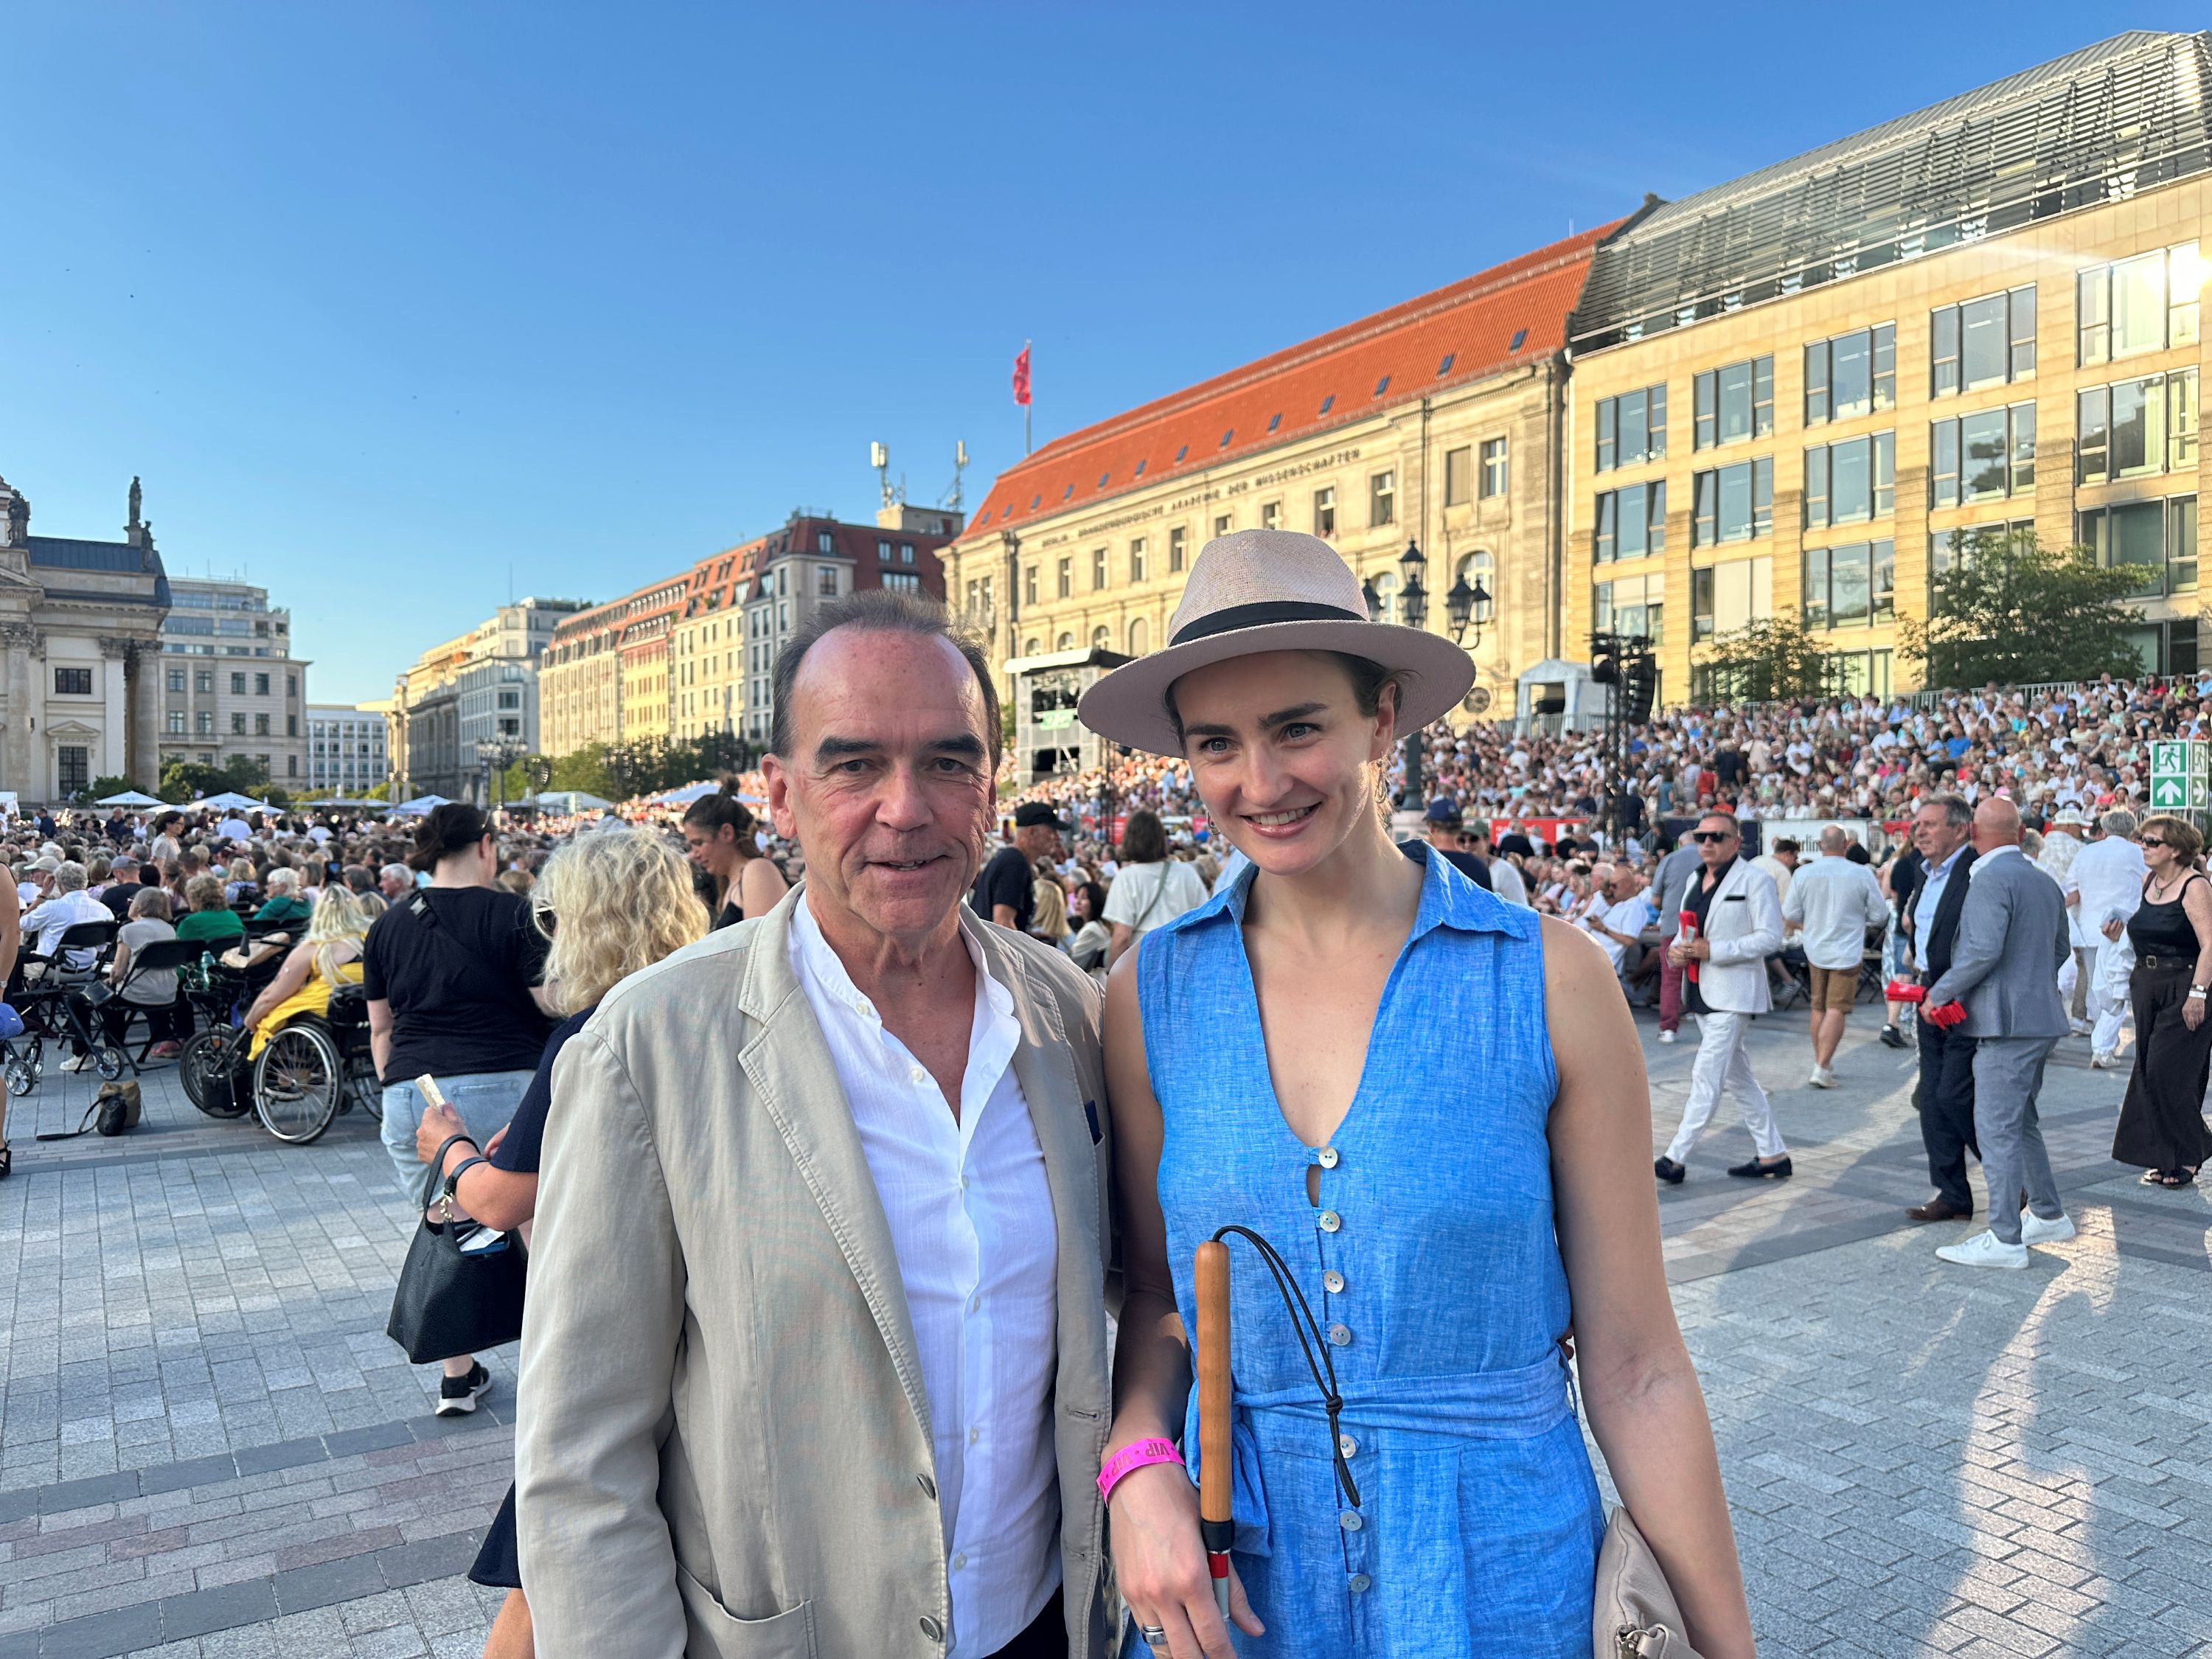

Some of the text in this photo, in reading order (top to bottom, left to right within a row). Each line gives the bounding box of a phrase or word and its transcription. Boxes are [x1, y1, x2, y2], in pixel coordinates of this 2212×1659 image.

[1790, 834, 1819, 852] rlin
[1111, 1442, 1171, 1476] VIP VIP
